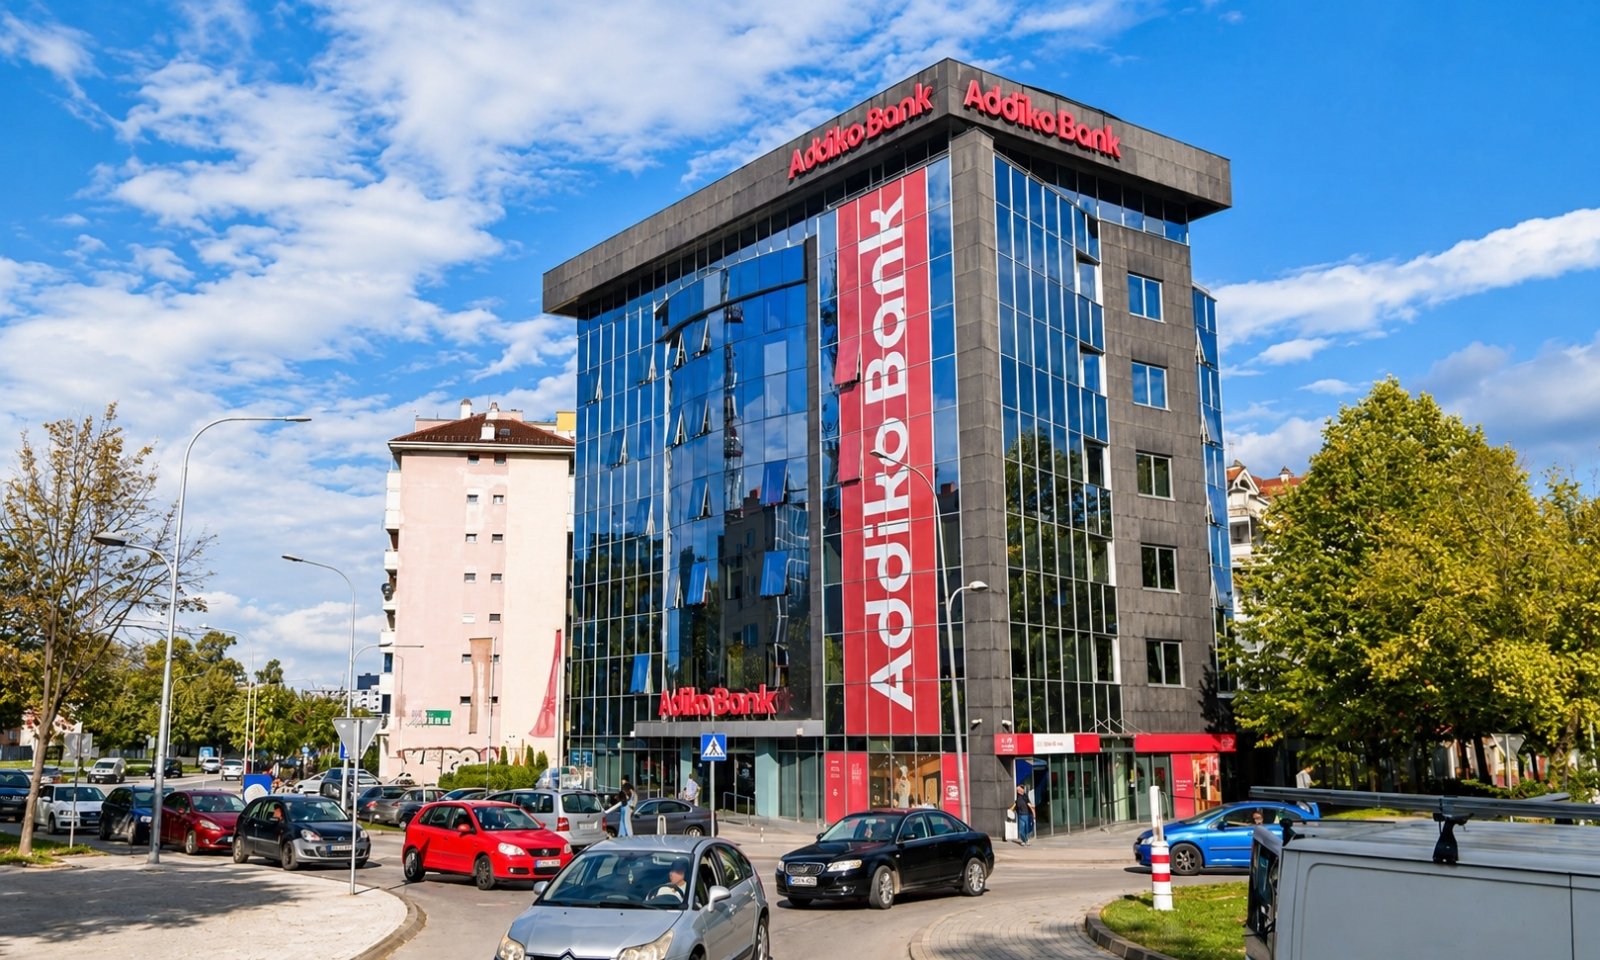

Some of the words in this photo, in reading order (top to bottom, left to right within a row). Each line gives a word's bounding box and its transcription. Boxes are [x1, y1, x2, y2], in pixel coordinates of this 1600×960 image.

[788, 123, 866, 179] Addiko
[866, 83, 934, 139] Bank
[964, 80, 1056, 134] Addiko
[1057, 109, 1121, 160] Bank
[857, 194, 908, 405] Bank
[864, 417, 913, 712] Addiko
[713, 684, 777, 716] Bank
